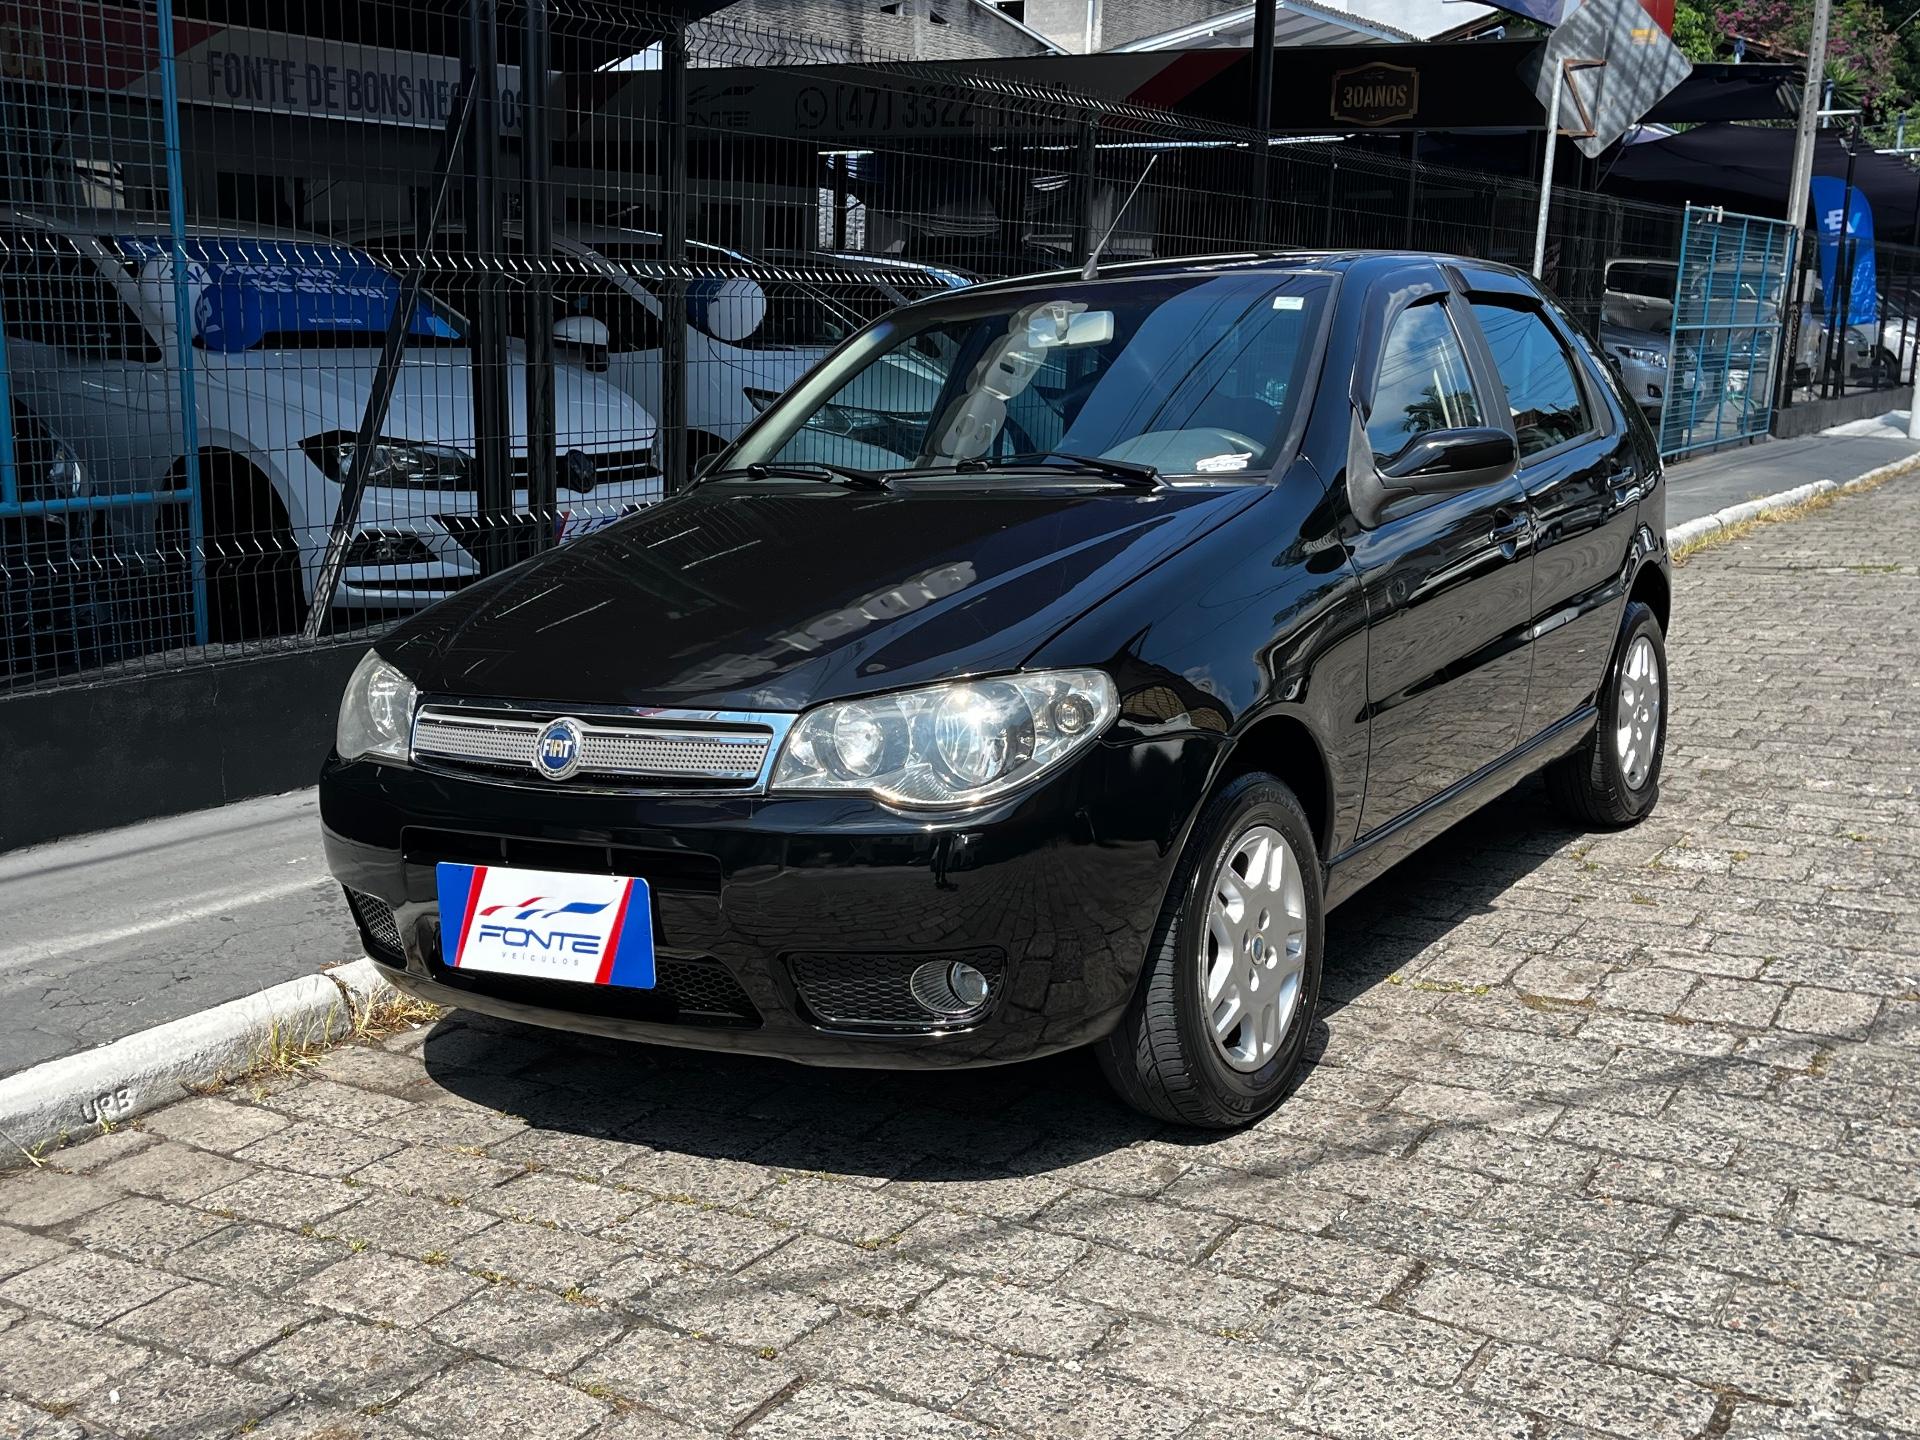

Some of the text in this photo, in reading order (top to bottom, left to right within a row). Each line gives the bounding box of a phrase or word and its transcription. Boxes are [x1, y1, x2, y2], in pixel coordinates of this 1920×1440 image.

[206, 51, 298, 105] FONTE
[304, 61, 341, 110] DE
[345, 68, 413, 118] BONS
[543, 738, 573, 760] FIAT
[478, 924, 602, 955] FONTE
[501, 951, 579, 967] VEÍCULOS
